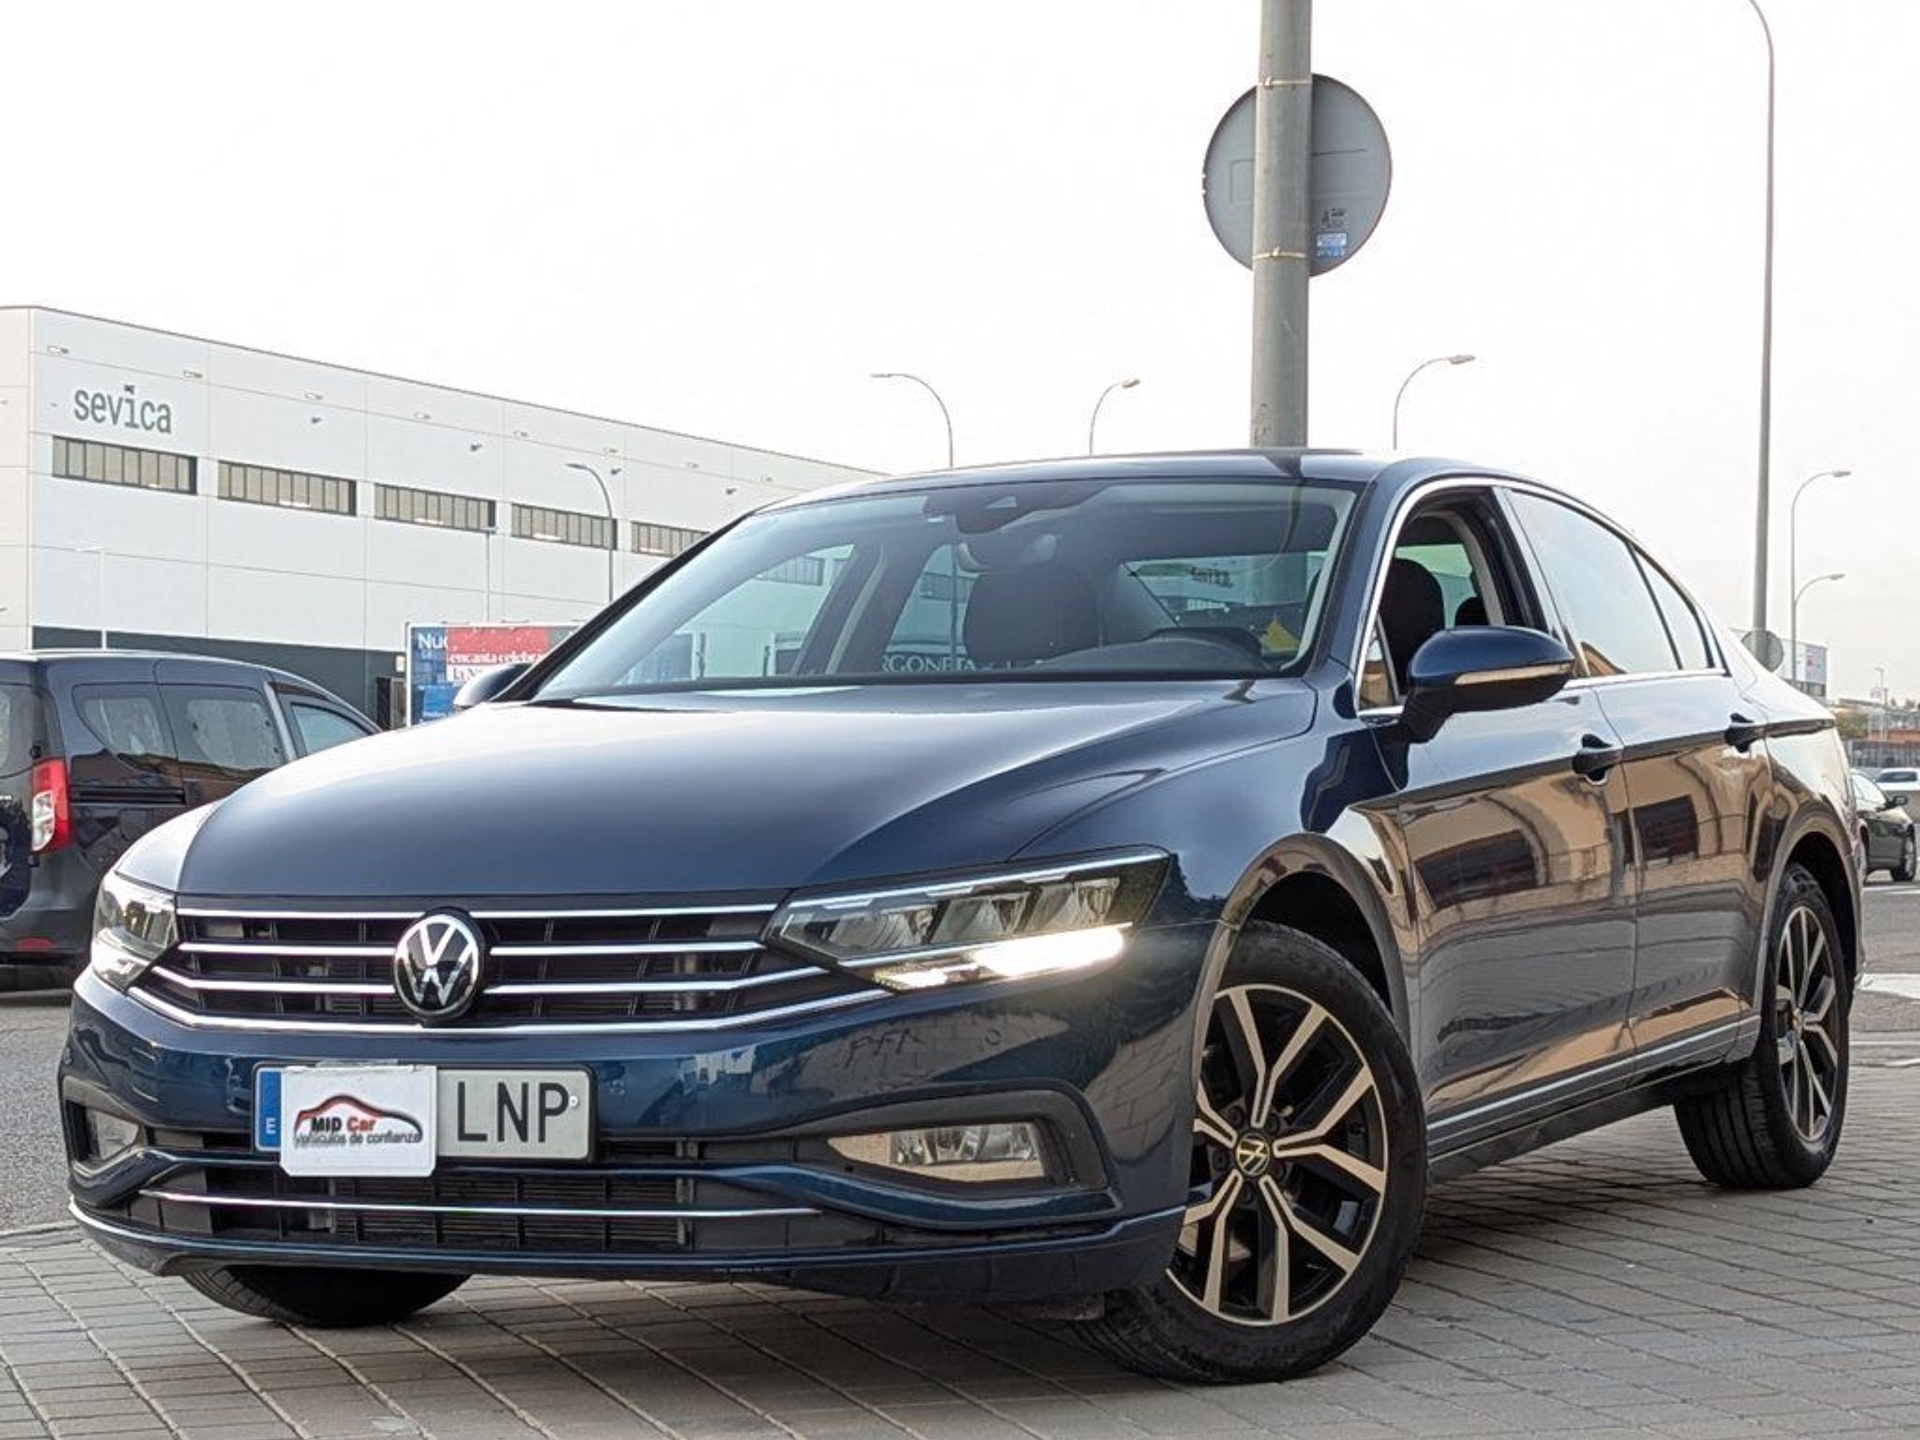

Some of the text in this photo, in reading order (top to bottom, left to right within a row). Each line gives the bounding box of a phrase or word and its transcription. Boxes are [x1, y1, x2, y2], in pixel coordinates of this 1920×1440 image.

[74, 385, 171, 434] sevica
[458, 1081, 569, 1143] LNP
[266, 1117, 276, 1134] E
[311, 1117, 377, 1131] MID Car
[349, 1132, 363, 1144] de
